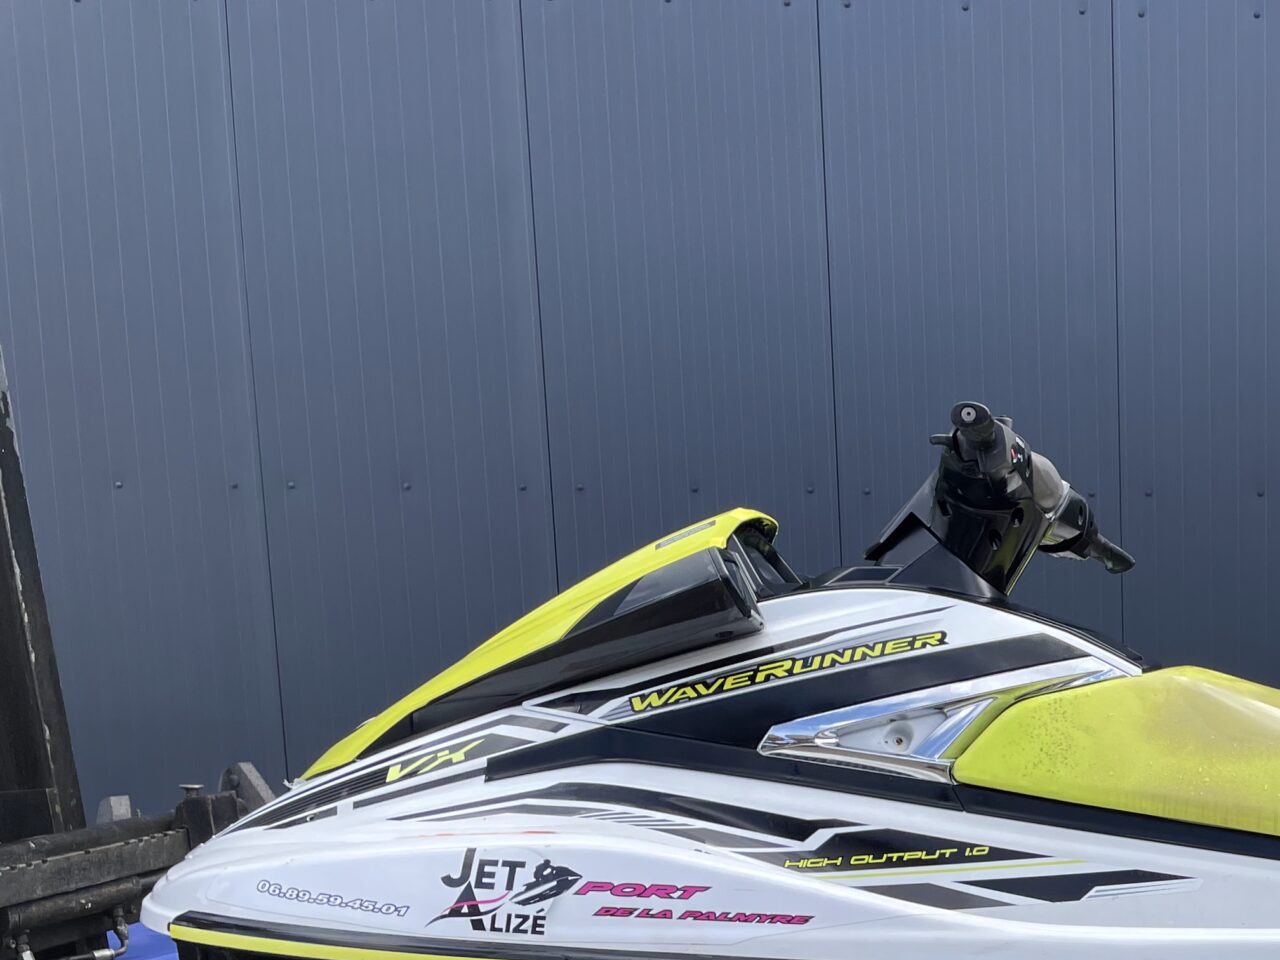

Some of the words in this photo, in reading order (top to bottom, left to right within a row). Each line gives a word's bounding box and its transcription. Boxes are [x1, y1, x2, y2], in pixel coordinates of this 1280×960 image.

[386, 739, 485, 783] VX
[441, 848, 526, 891] JET
[784, 857, 842, 868] HIGH
[850, 848, 957, 865] OUTPUT
[257, 880, 410, 917] 06.89.59.45.01
[447, 880, 546, 935] ALIZÉ
[573, 881, 712, 900] PORT
[593, 906, 637, 918] DE
[635, 908, 673, 919] LA
[677, 911, 815, 925] PALMYRE
